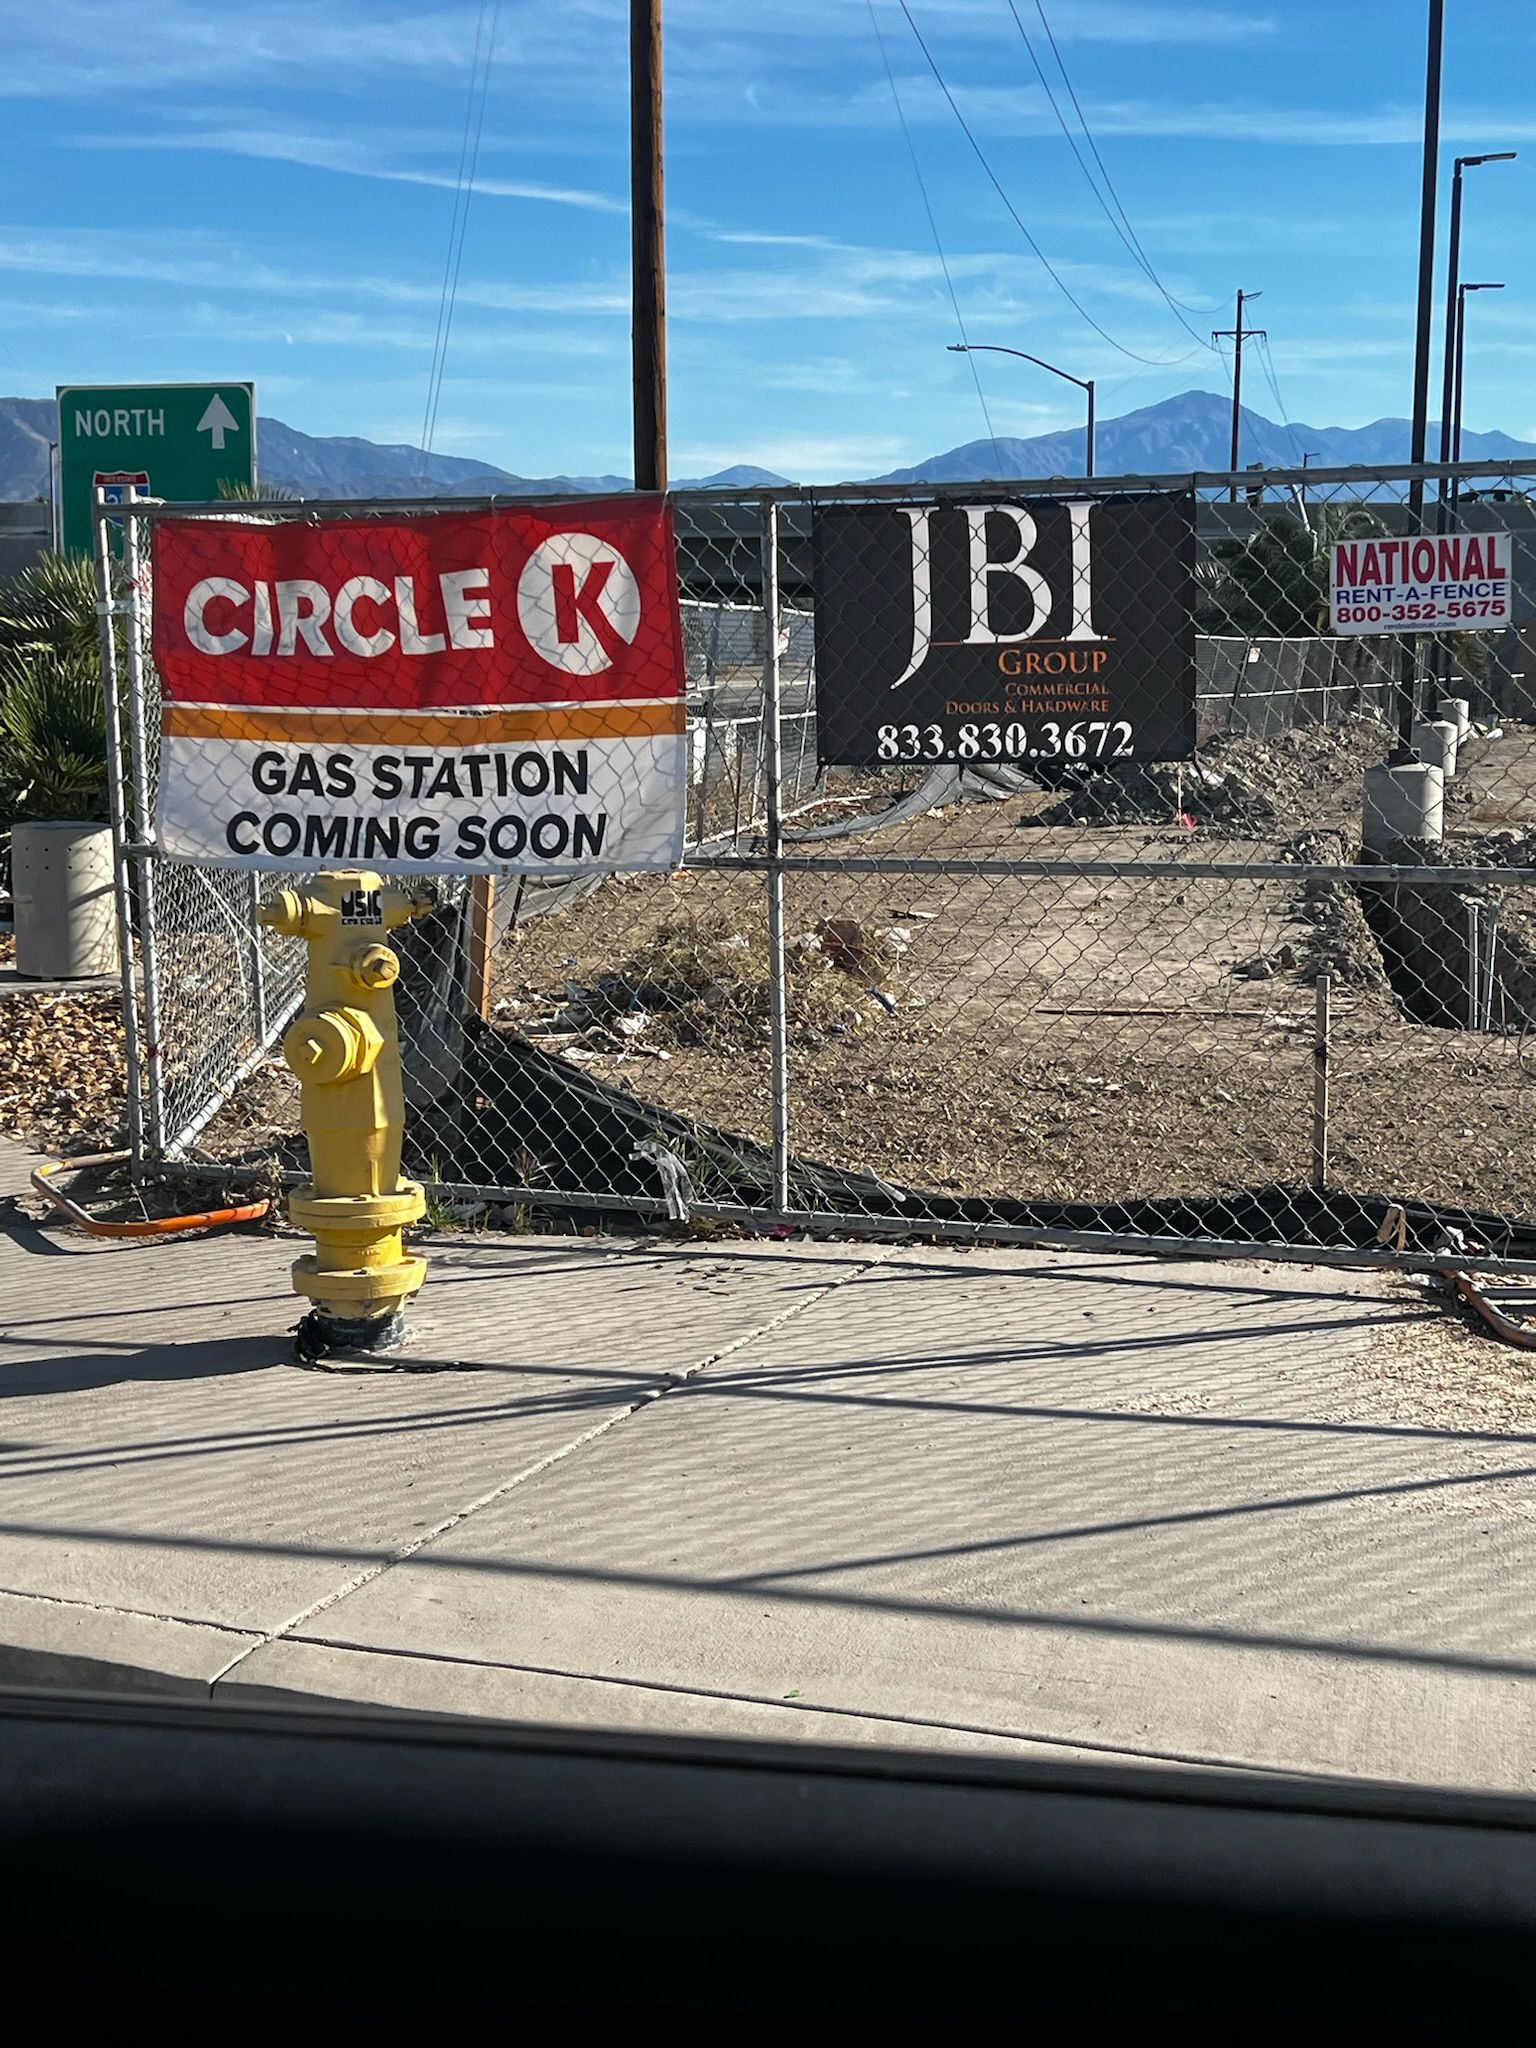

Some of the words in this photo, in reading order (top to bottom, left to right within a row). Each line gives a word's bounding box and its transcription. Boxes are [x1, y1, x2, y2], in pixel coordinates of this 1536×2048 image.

[75, 408, 165, 437] NORTH
[1336, 535, 1507, 588] NATIONAL
[890, 500, 1109, 690] JBI
[1336, 581, 1507, 605] RENT-A-FENCE
[184, 567, 495, 658] CIRCLE
[1336, 600, 1507, 625] 800-352-5675
[998, 648, 1109, 676] GROUP
[1004, 681, 1110, 697] COMMERCIAL
[945, 700, 1000, 715] DOORS
[1004, 699, 1017, 714] &
[1021, 699, 1110, 714] HARDWARE
[876, 720, 1136, 761] 833.830.3672
[251, 750, 357, 799] GAS
[372, 749, 588, 800] STATION
[226, 811, 440, 860] COMING
[454, 812, 607, 860] SOON
